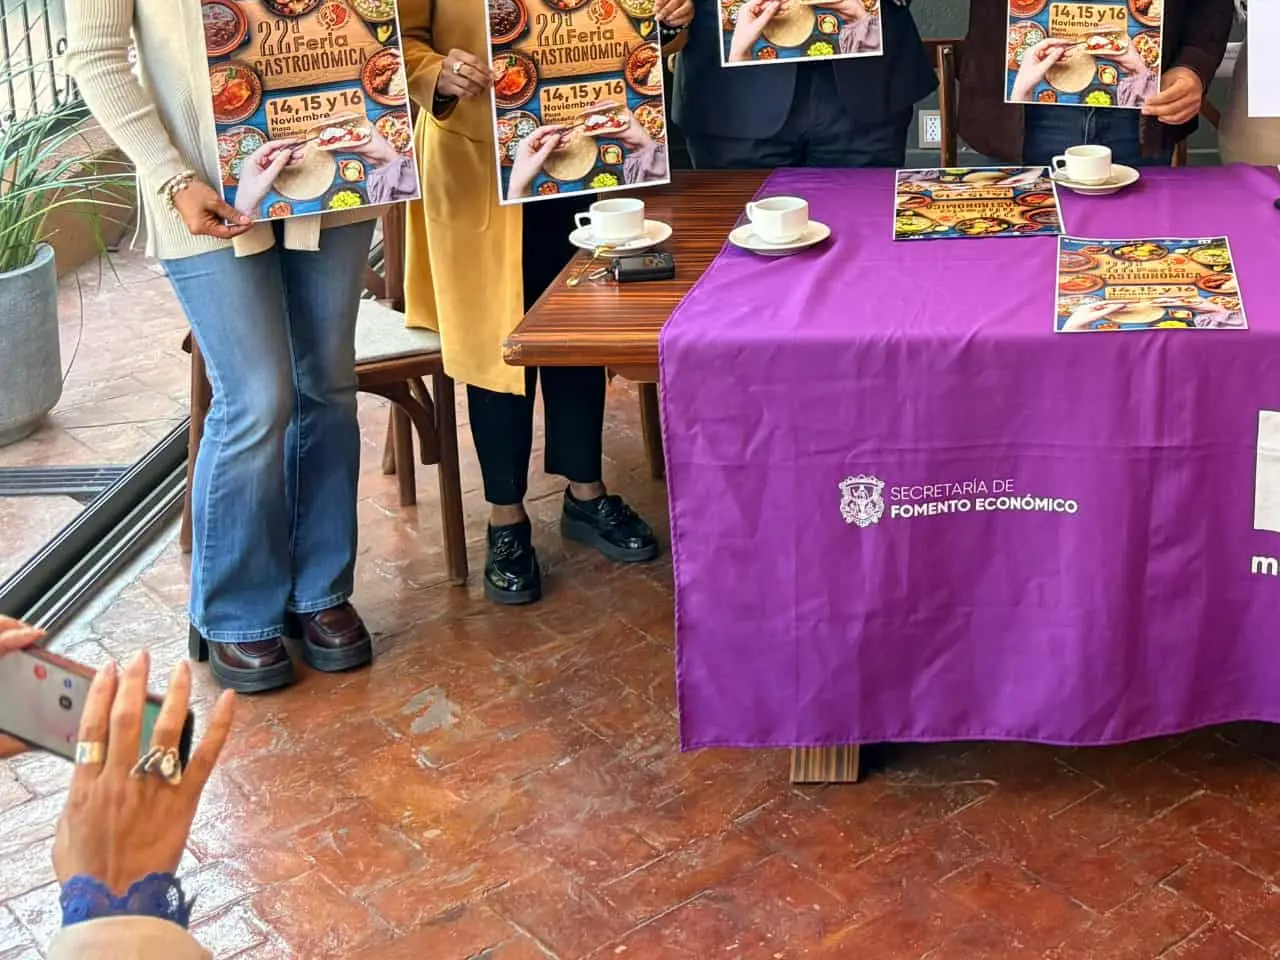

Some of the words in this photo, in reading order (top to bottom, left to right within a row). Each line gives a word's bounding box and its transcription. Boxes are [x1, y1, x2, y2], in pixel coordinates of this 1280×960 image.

[1052, 19, 1098, 27] Noviembre
[1097, 9, 1106, 22] y
[1109, 7, 1125, 19] 16
[293, 32, 348, 52] Feria
[567, 26, 614, 44] Feria
[255, 47, 367, 76] GASTRONÓMICA
[532, 41, 630, 66] GASTRONÓMICA
[593, 87, 602, 100] y
[605, 81, 623, 95] 16
[327, 96, 338, 111] y
[340, 90, 362, 106] 16
[544, 101, 596, 112] Noviembre
[271, 112, 330, 126] Noviembre
[890, 478, 988, 501] SECRETARÍA
[993, 479, 1014, 492] DE
[890, 498, 971, 519] FOMENTO
[976, 494, 1078, 515] ECONÓMICO
